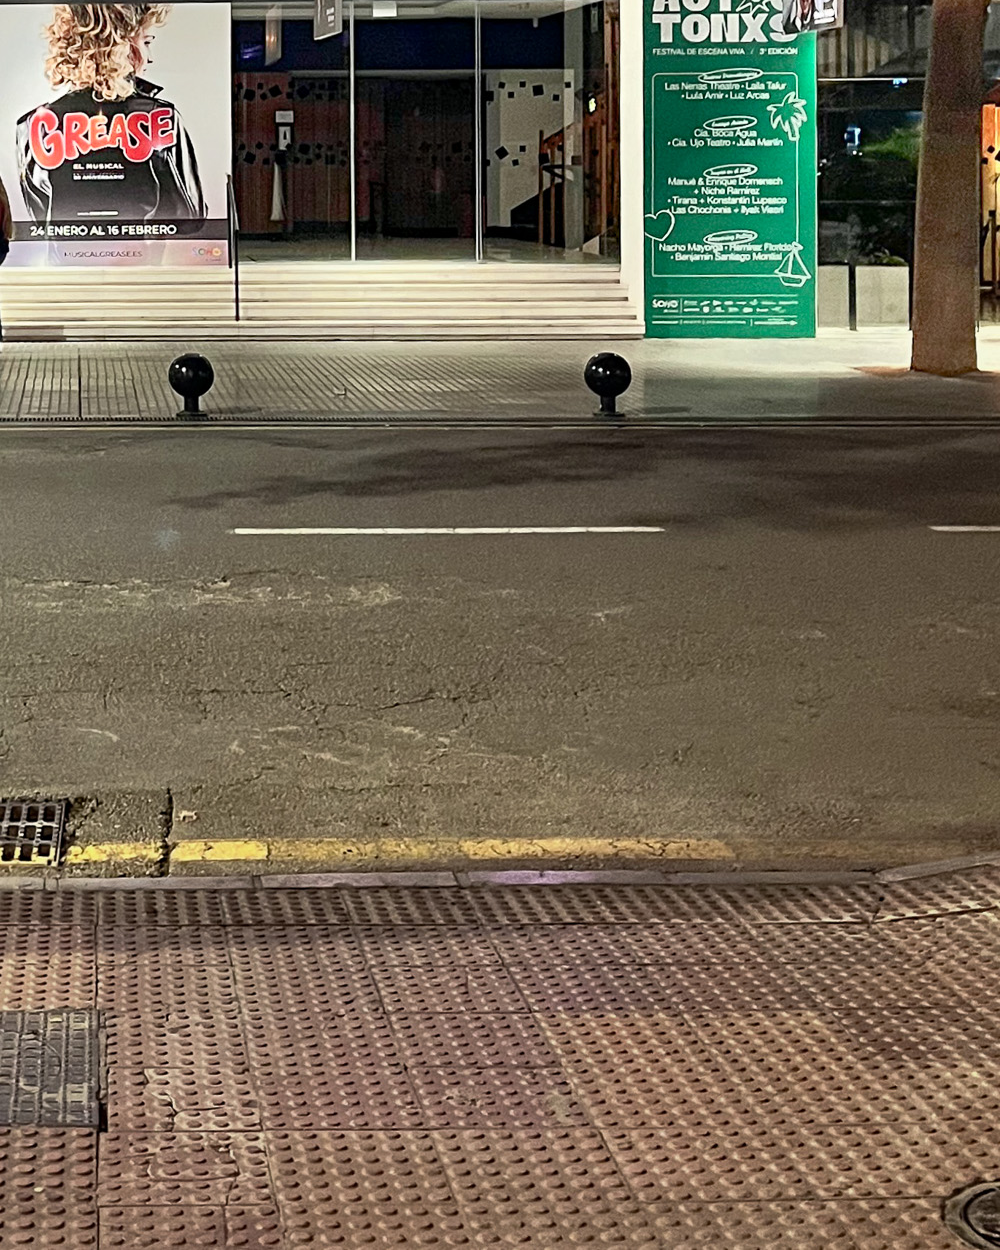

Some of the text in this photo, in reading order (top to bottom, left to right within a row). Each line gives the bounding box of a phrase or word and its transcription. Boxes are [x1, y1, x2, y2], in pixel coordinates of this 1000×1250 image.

[652, 13, 798, 43] TONXS
[652, 48, 686, 56] FESTIVAL
[767, 46, 798, 55] EDICIÓN
[28, 106, 177, 169] GREASE
[30, 224, 178, 237] 24 ENERO AL 16 FEBRERO
[652, 299, 679, 308] SOHO
